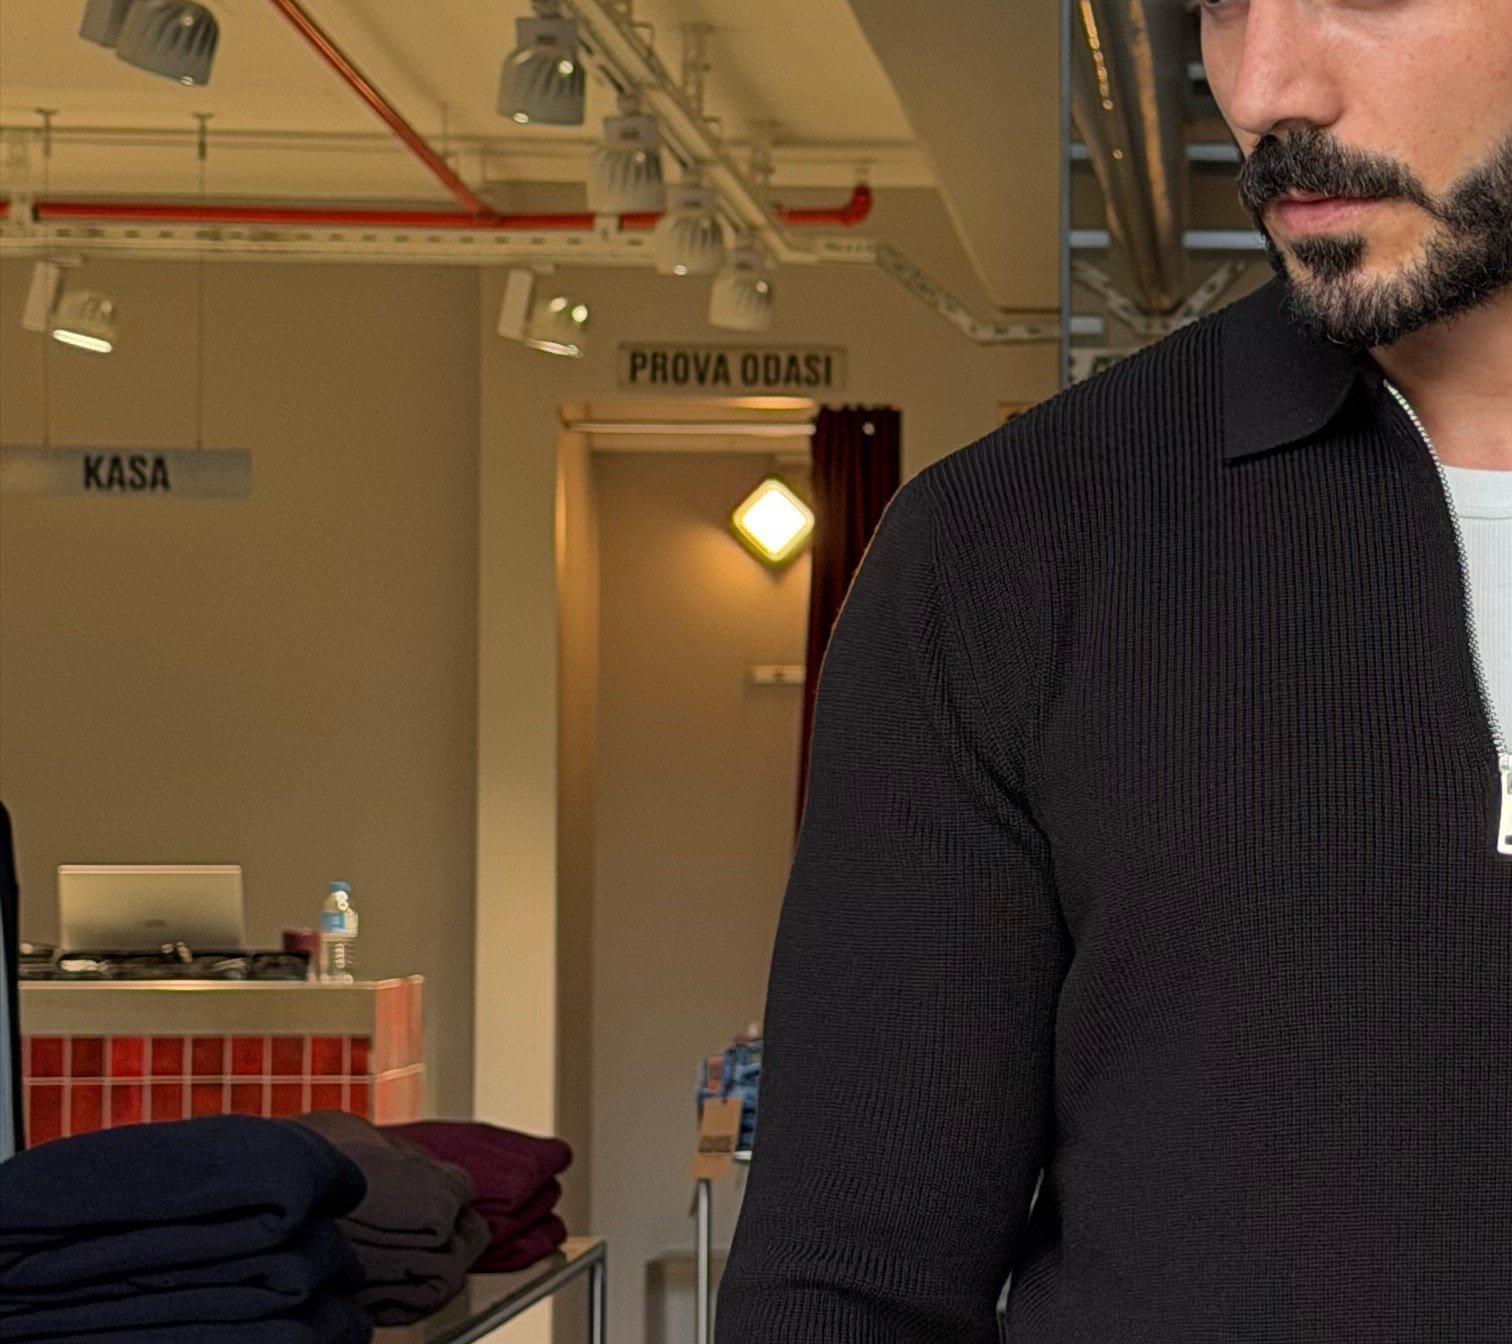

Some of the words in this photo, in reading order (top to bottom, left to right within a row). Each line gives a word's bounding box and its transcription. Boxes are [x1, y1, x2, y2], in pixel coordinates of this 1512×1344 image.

[629, 351, 730, 386] PROVA
[740, 352, 832, 387] ODASI
[83, 454, 170, 491] KASA
